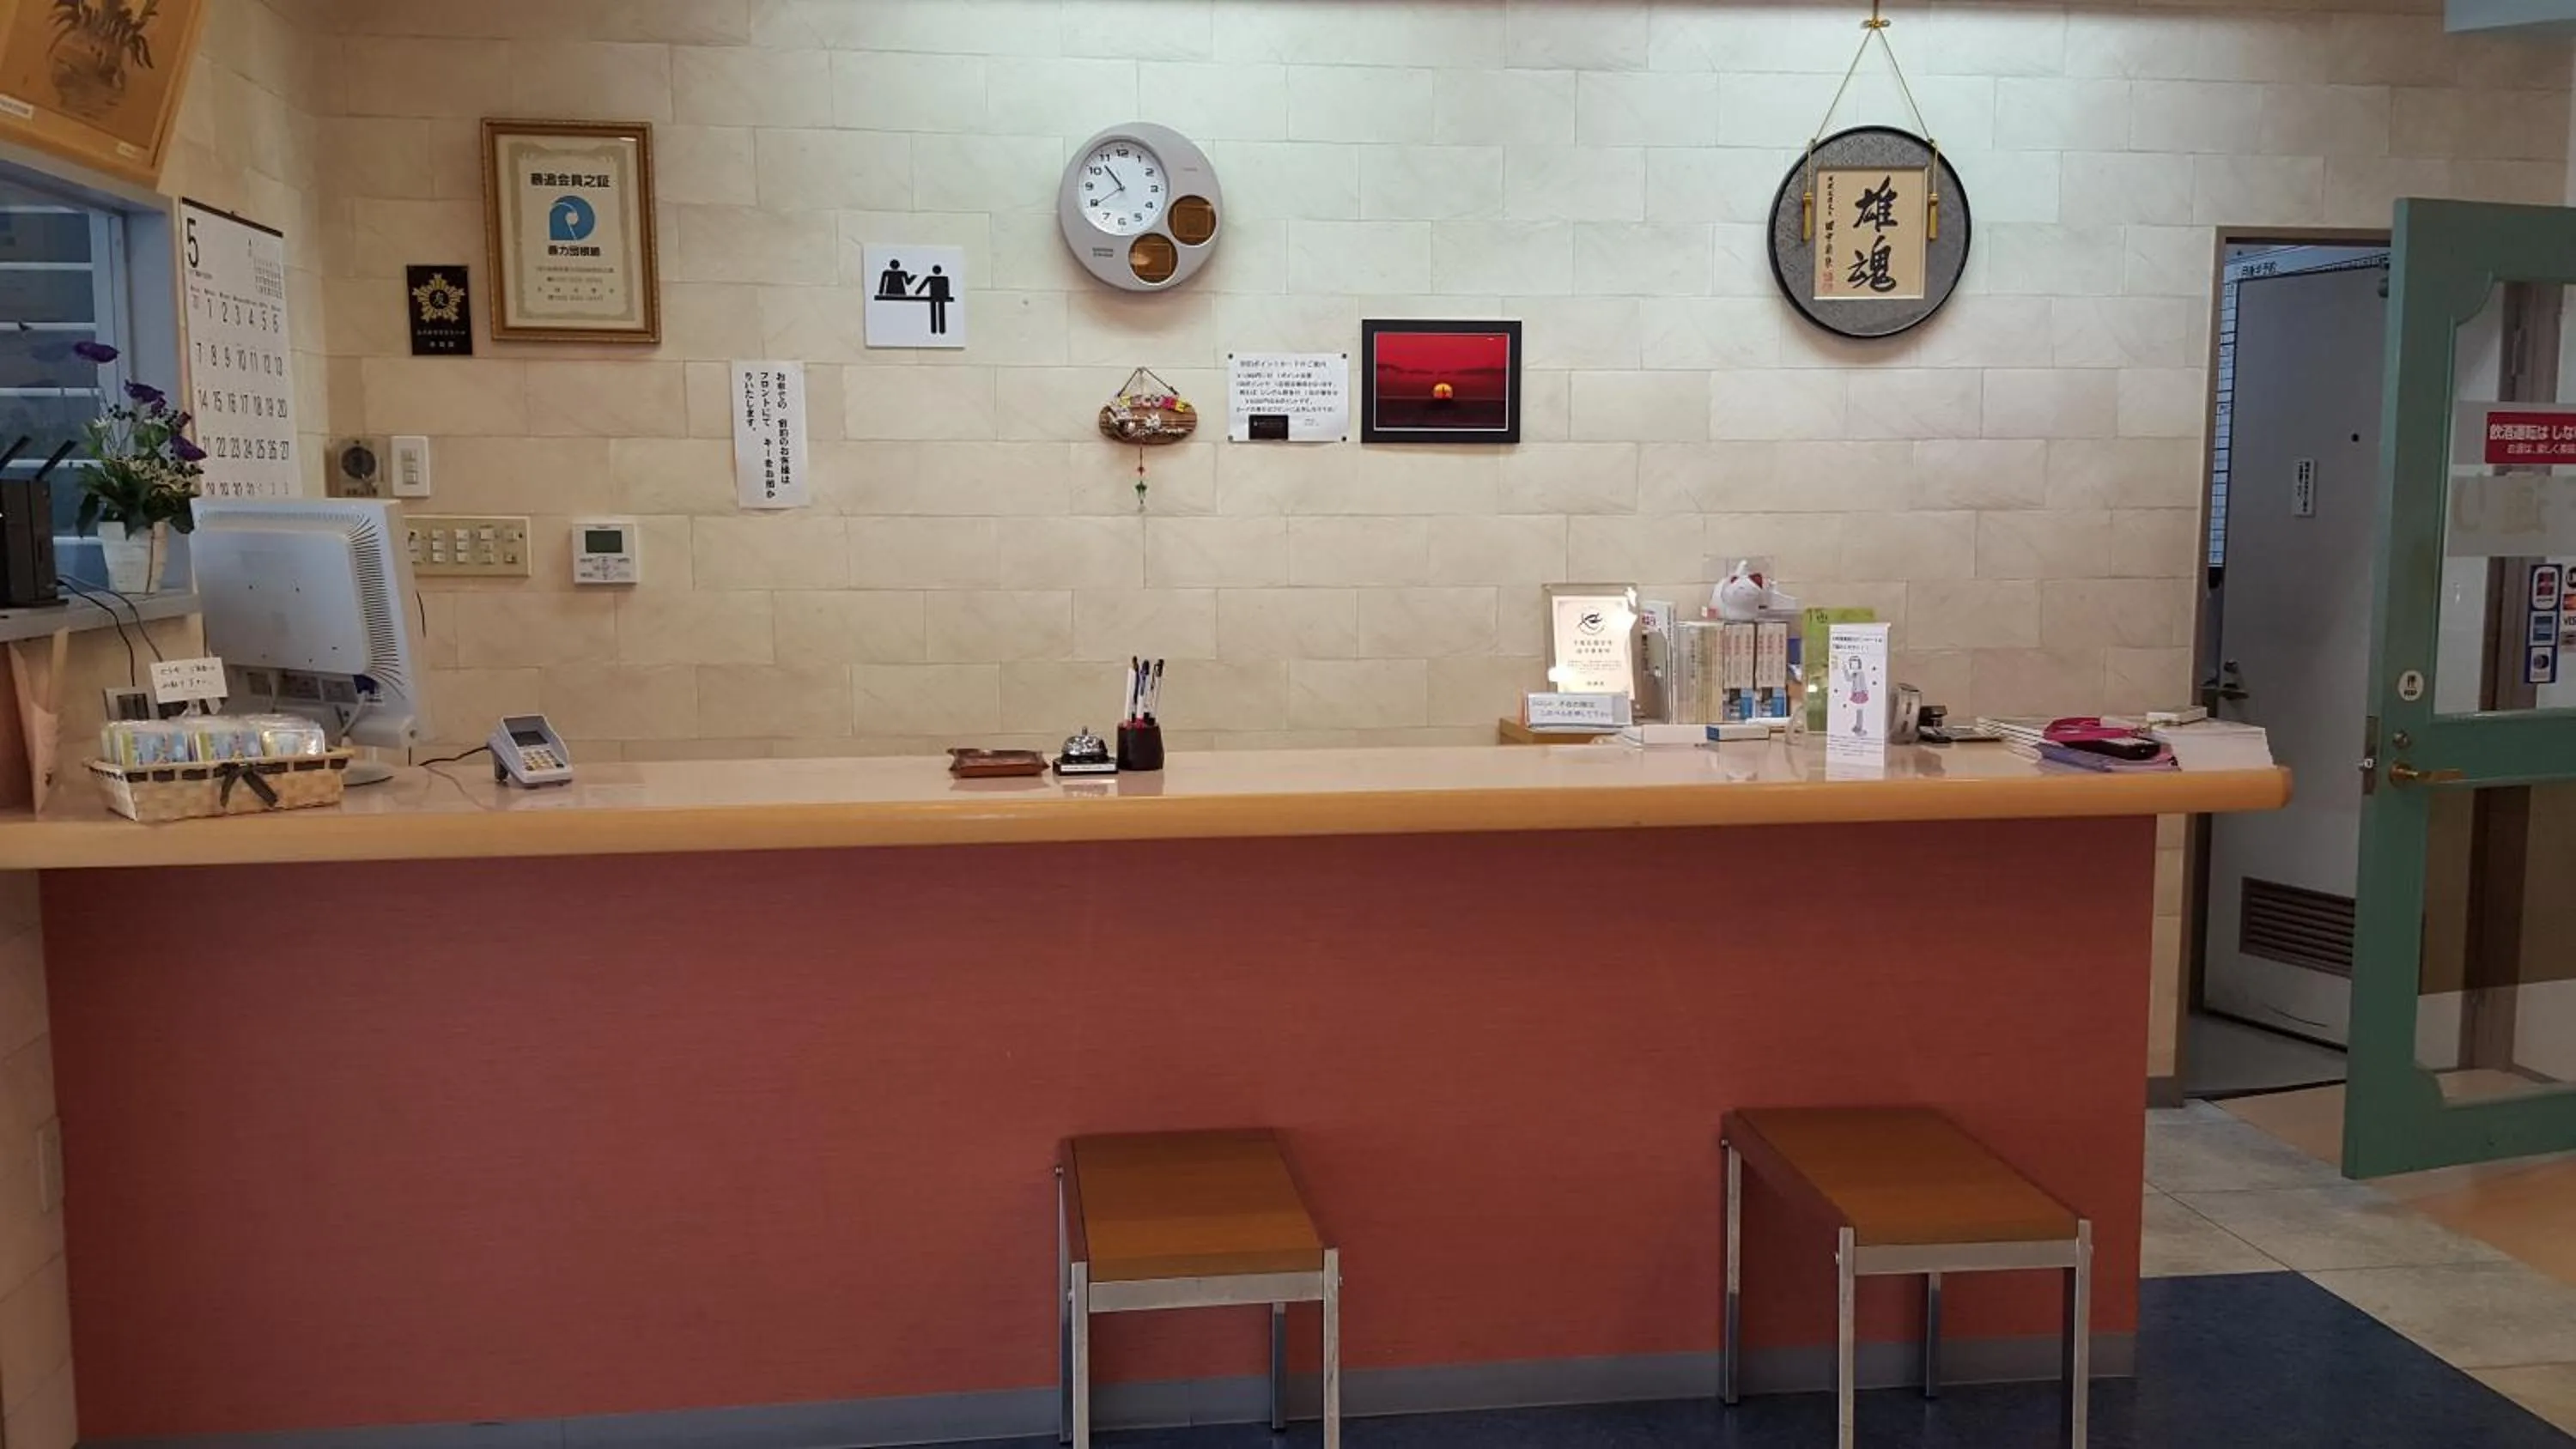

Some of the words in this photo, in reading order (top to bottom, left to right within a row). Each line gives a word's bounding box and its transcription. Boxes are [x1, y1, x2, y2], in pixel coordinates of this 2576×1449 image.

[1116, 149, 1129, 158] 12
[1137, 155, 1141, 163] 1
[1088, 167, 1103, 176] 10
[1145, 167, 1155, 177] 2
[1084, 181, 1094, 191] 9
[1150, 185, 1158, 193] 3
[1090, 198, 1098, 208] 8
[1145, 201, 1153, 209] 4
[1102, 212, 1111, 221] 7
[1117, 217, 1127, 226] 6
[1134, 212, 1143, 222] 5
[185, 216, 199, 269] 5
[207, 297, 213, 319] 1
[222, 301, 228, 323] 2
[234, 304, 241, 326] 3
[272, 313, 280, 334] 6
[195, 342, 203, 364] 7
[210, 343, 217, 367] 8
[225, 346, 232, 368] 9
[237, 349, 247, 372] 10
[250, 351, 258, 373] 11
[262, 354, 271, 375] 12
[275, 356, 283, 377] 13
[198, 389, 208, 411] 14
[213, 391, 222, 413] 15
[228, 392, 237, 414] 16
[240, 394, 249, 414] 17
[277, 397, 288, 418] 20
[216, 436, 227, 458] 22
[230, 437, 240, 459] 23
[243, 439, 252, 459] 24
[256, 439, 265, 459] 25
[280, 440, 289, 460] 27
